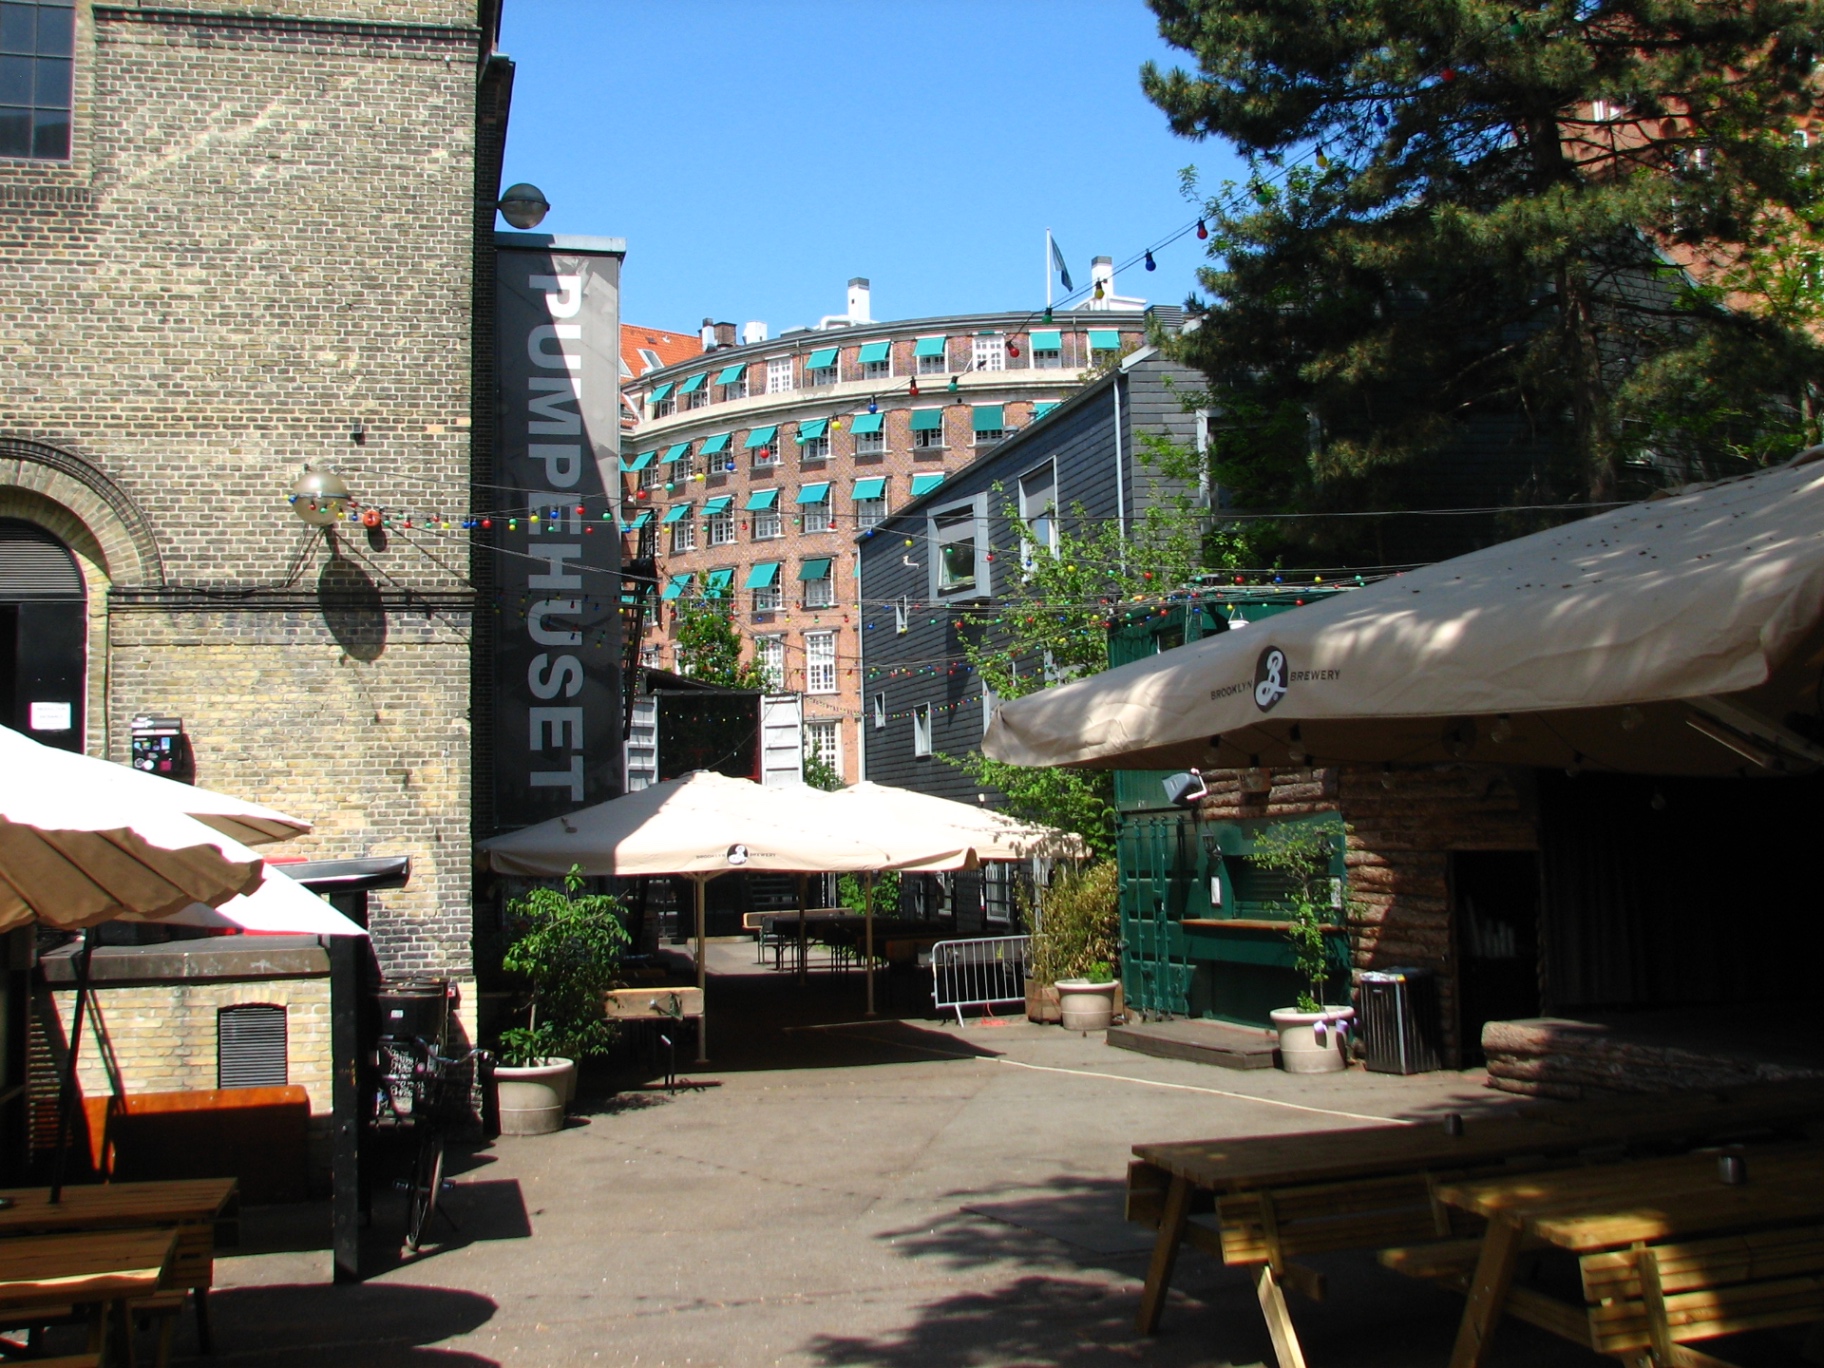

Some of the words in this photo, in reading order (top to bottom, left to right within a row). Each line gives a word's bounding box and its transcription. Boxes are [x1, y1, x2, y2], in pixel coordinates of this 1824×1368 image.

[528, 274, 584, 802] PUMPEHUSET
[1210, 680, 1253, 700] BROOKLYN
[1290, 669, 1341, 682] BREWERY
